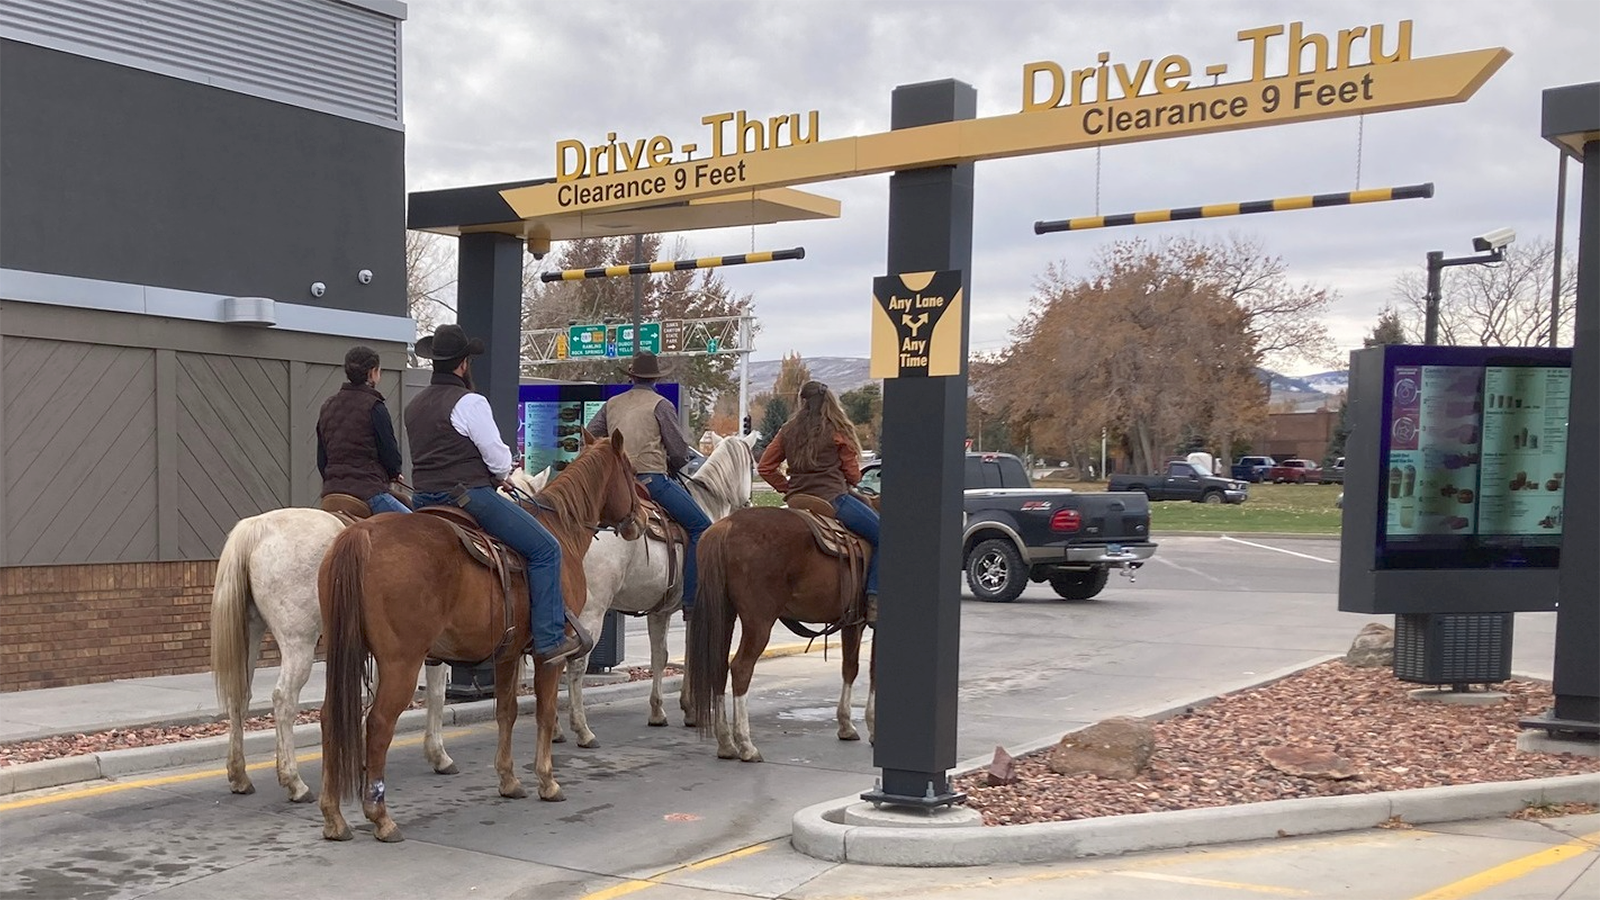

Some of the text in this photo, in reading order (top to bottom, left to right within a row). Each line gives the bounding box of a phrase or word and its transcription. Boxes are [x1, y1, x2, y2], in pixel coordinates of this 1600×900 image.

[1082, 72, 1374, 135] Clearance 9 Feet
[557, 159, 746, 207] Clearance 9 Feet
[889, 294, 944, 313] Any Lane
[608, 344, 615, 352] H
[902, 337, 926, 355] Any
[900, 353, 928, 368] Time
